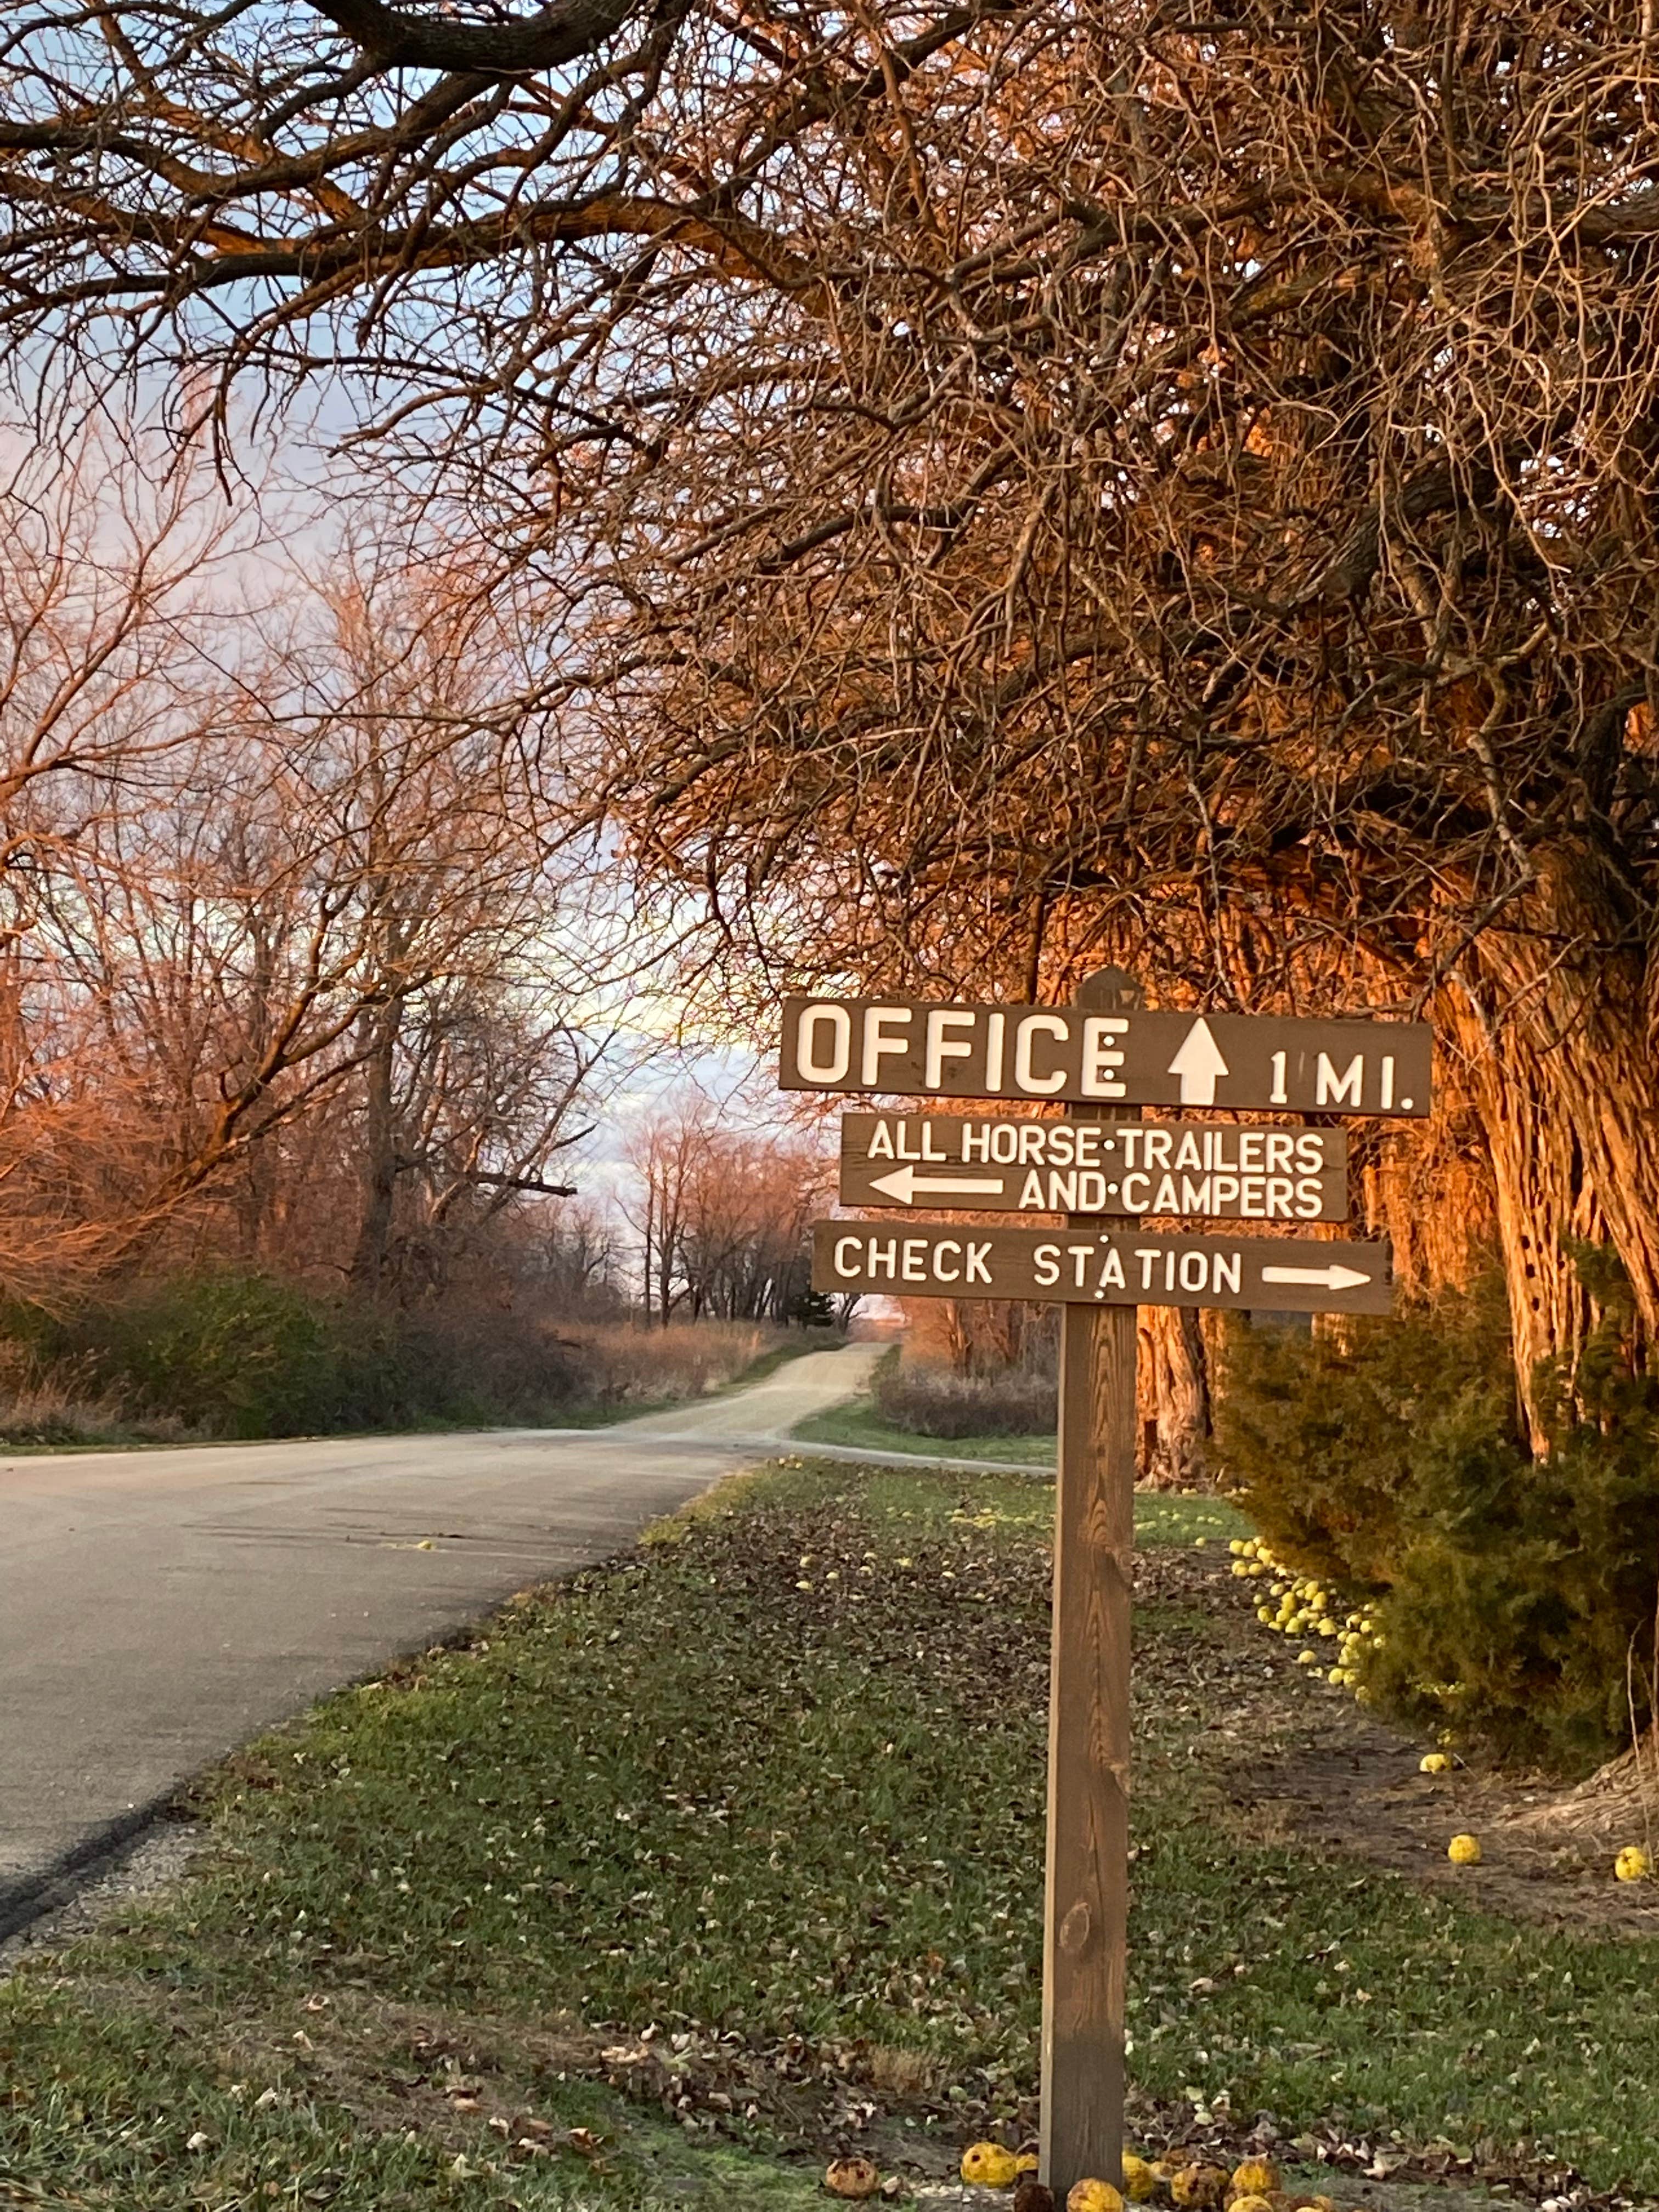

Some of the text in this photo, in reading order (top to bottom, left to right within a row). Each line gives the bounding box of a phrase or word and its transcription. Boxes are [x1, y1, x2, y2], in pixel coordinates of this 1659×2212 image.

[797, 1004, 1414, 1110] OFFICE 1 MI.
[867, 1120, 1324, 1174] ALL HORSE TRAILERS
[1019, 1170, 1323, 1218] AND CAMPERS
[834, 1236, 1242, 1294] CHECK STATION
